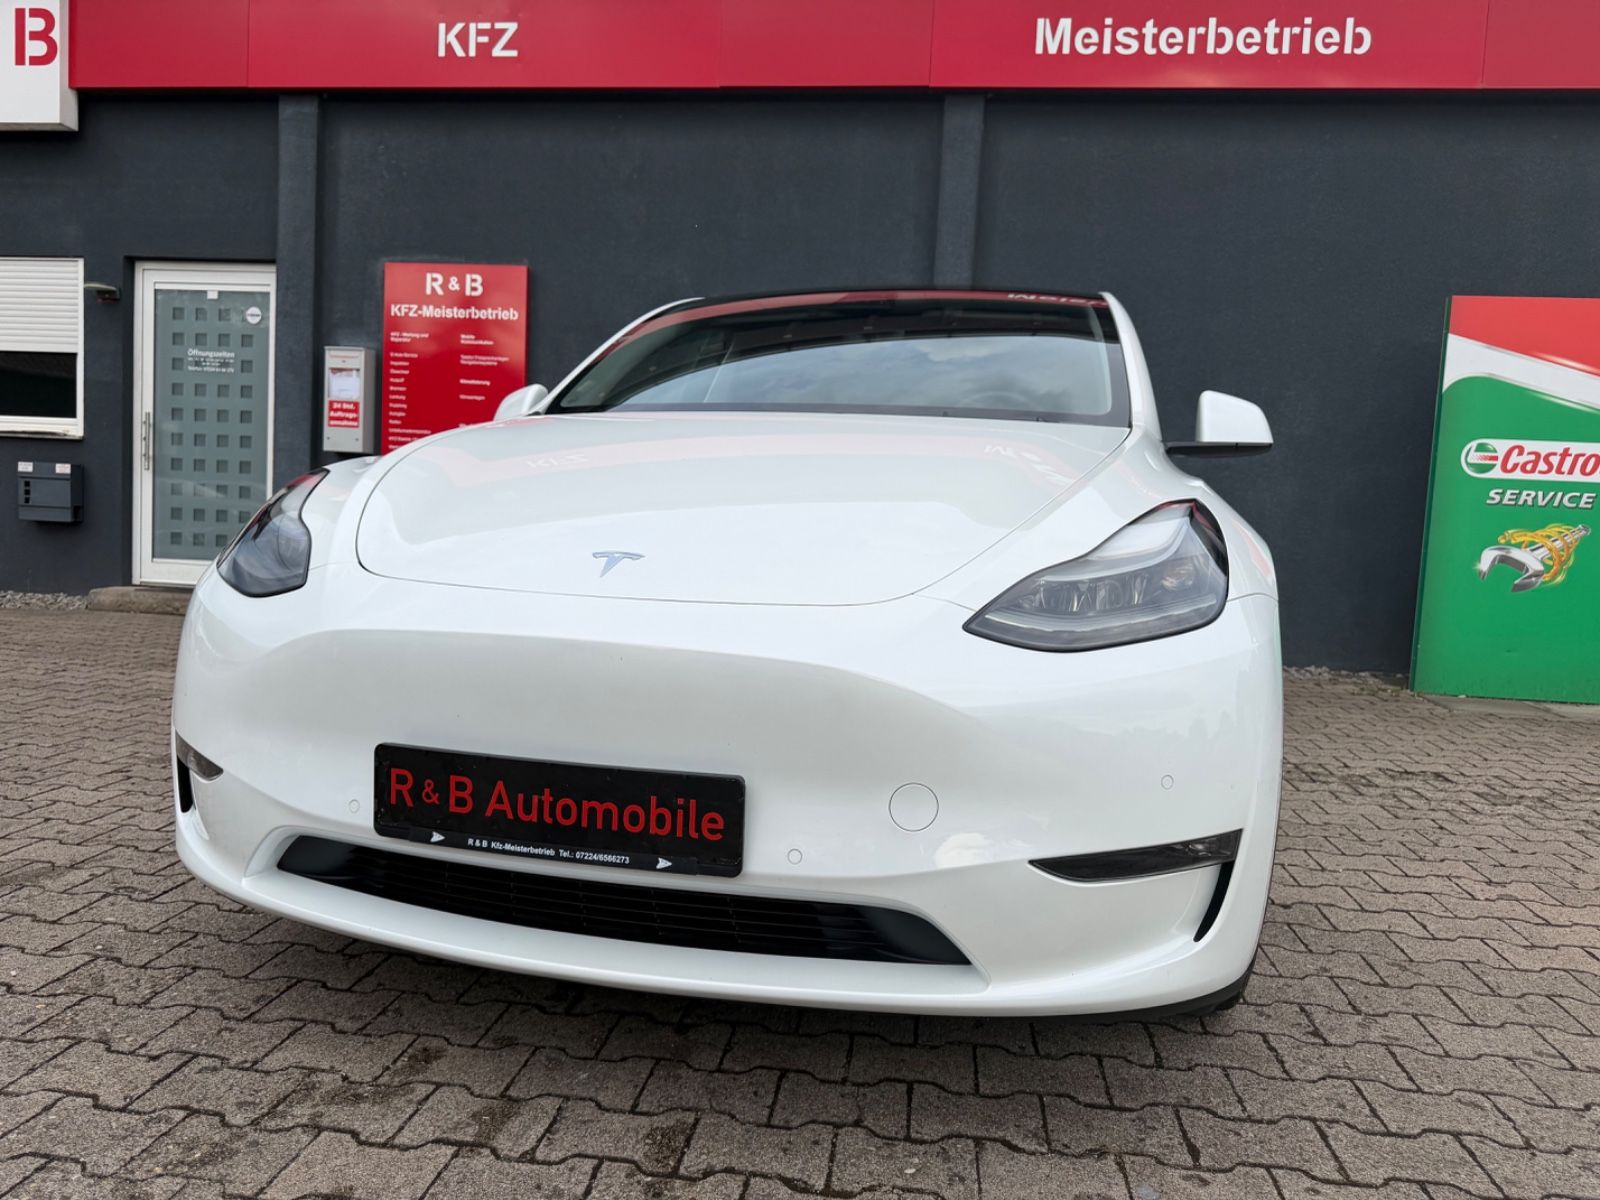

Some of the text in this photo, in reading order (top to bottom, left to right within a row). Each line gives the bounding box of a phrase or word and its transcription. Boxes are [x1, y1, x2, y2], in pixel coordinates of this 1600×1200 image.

[15, 8, 58, 66] B
[437, 21, 519, 58] KFZ
[1035, 17, 1372, 56] Meisterbetrieb
[425, 272, 483, 296] R & B
[390, 304, 519, 321] KFZ-Meisterbetrieb
[187, 348, 235, 357] Öffnungszeiten
[1500, 445, 1600, 476] Castro
[1486, 489, 1596, 509] SERVICE
[390, 767, 725, 841] R & B Automobile
[467, 838, 474, 846] R
[475, 839, 481, 847] &
[482, 840, 488, 848] B
[491, 842, 556, 856] Kfz-Meisterbetrieb
